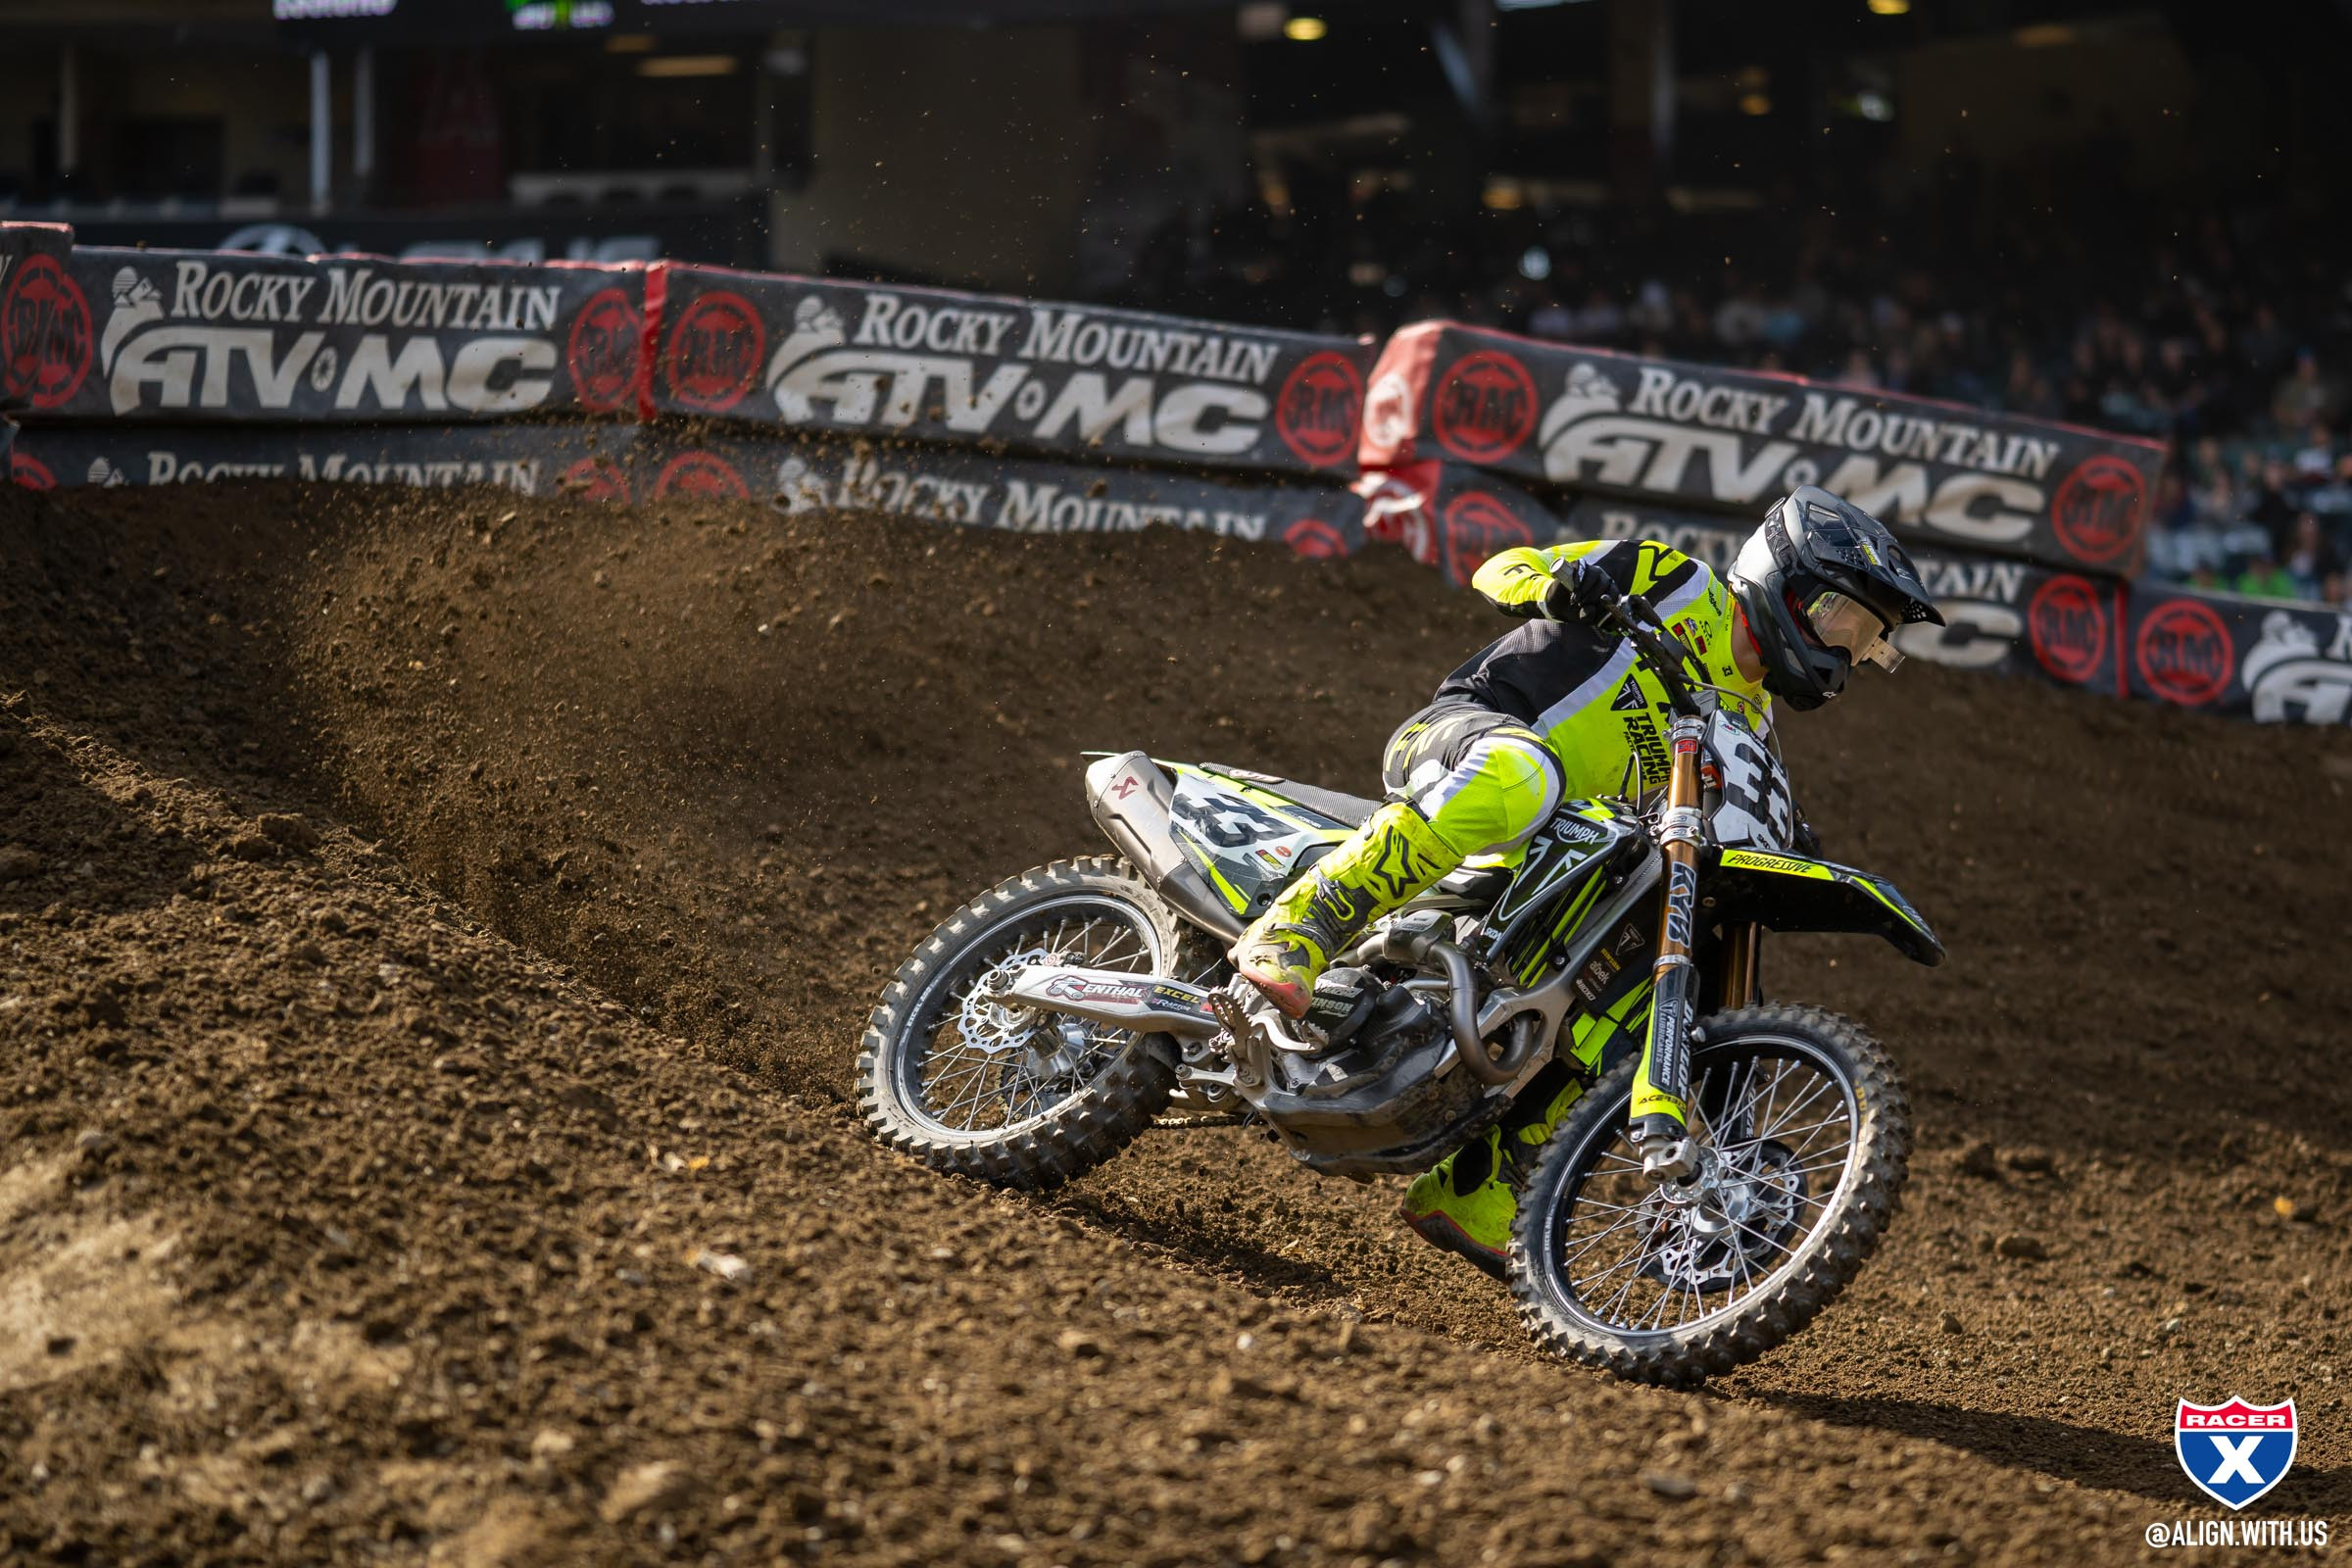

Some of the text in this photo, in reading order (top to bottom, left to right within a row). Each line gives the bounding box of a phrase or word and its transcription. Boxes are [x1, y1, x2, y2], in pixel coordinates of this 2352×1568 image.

[174, 261, 561, 330] ROCKY MOUNTAIN
[855, 294, 1280, 384] ROCKY MOUNTAIN
[1628, 366, 2062, 479] ROCKY MOUNTAIN
[1623, 716, 1660, 784] RACING
[1549, 817, 1599, 845] TRIUMPH
[1728, 854, 1813, 874] PROGRESSIVE
[1669, 862, 1696, 948] KYB
[1153, 985, 1201, 1004] EXCEL
[1655, 1012, 1666, 1062] LUBRICANTS
[1661, 1015, 1677, 1087] PERFORMANCE
